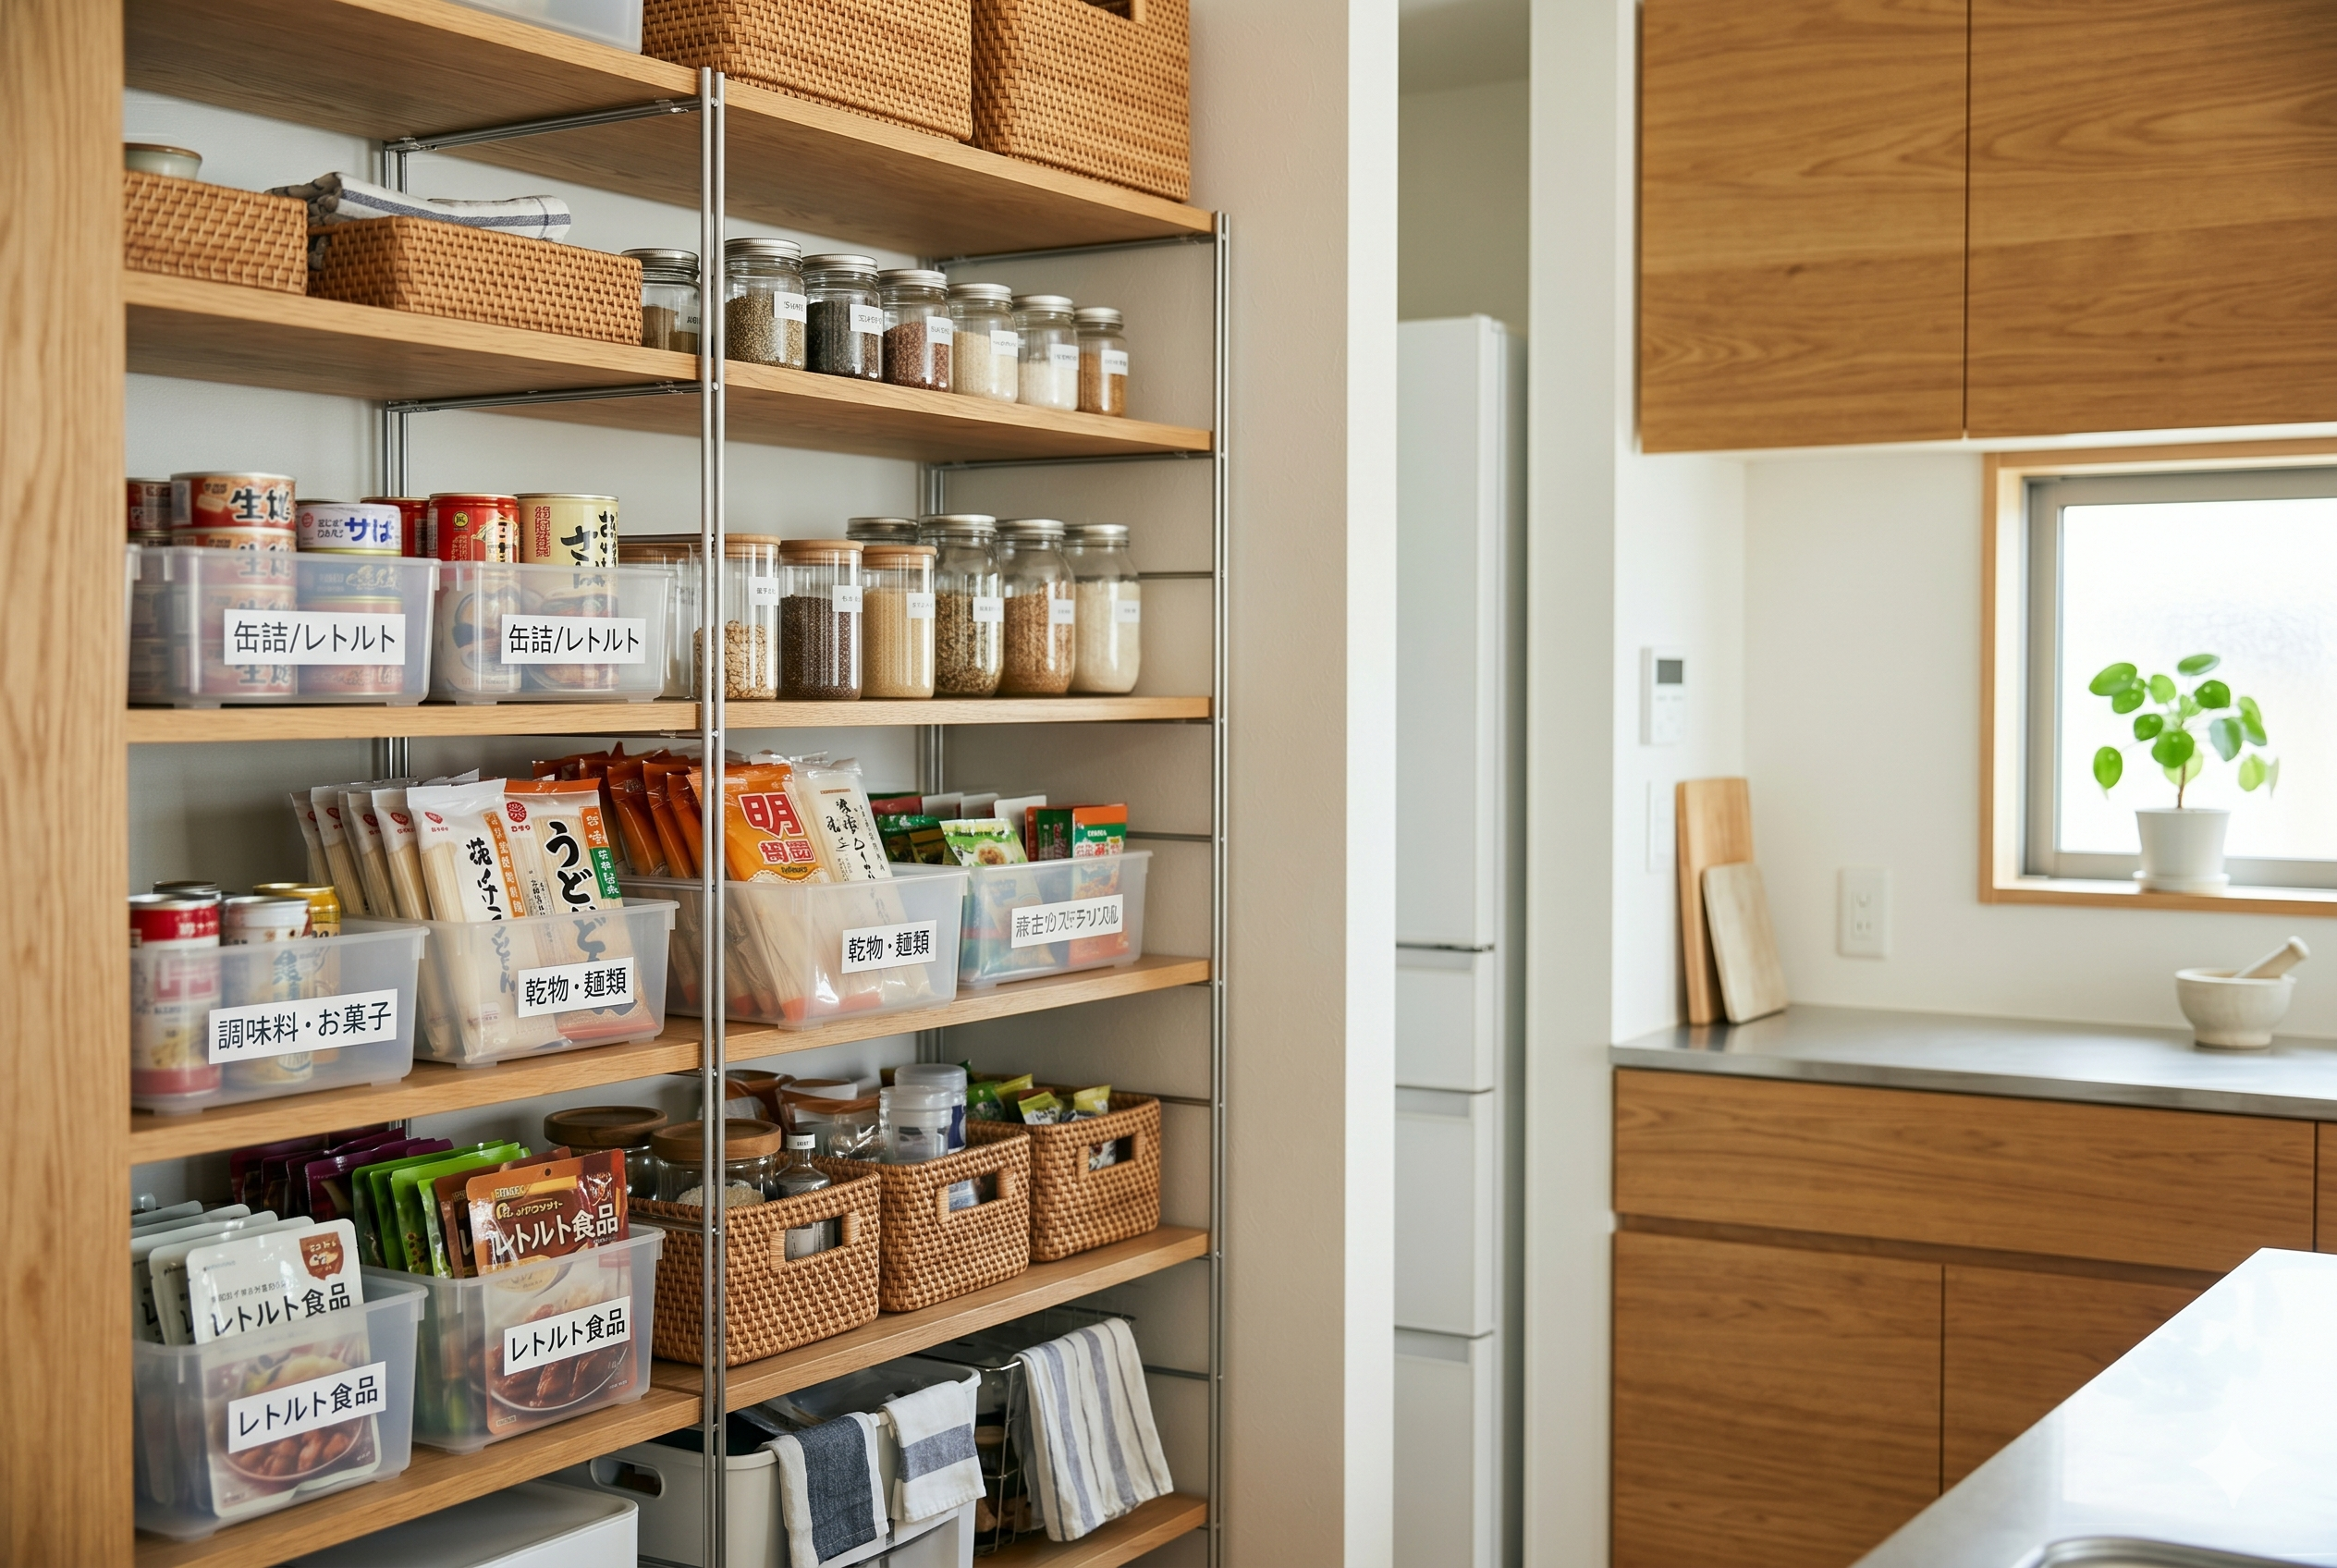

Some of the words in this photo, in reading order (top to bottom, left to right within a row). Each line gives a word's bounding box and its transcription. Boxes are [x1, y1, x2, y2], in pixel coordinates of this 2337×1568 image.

[234, 620, 396, 653] 缶詰/レトルト
[508, 624, 639, 654] 缶詰/レトルト
[849, 930, 929, 962] 乾物・麺類
[525, 967, 627, 1007] 乾物・麺類
[218, 1001, 392, 1049] 調味料・お菓子
[495, 1204, 618, 1256] レトルト食品
[211, 1282, 350, 1336] レトルト食品
[512, 1308, 625, 1361] レトルト食品
[240, 1376, 377, 1437] レトルト食品
